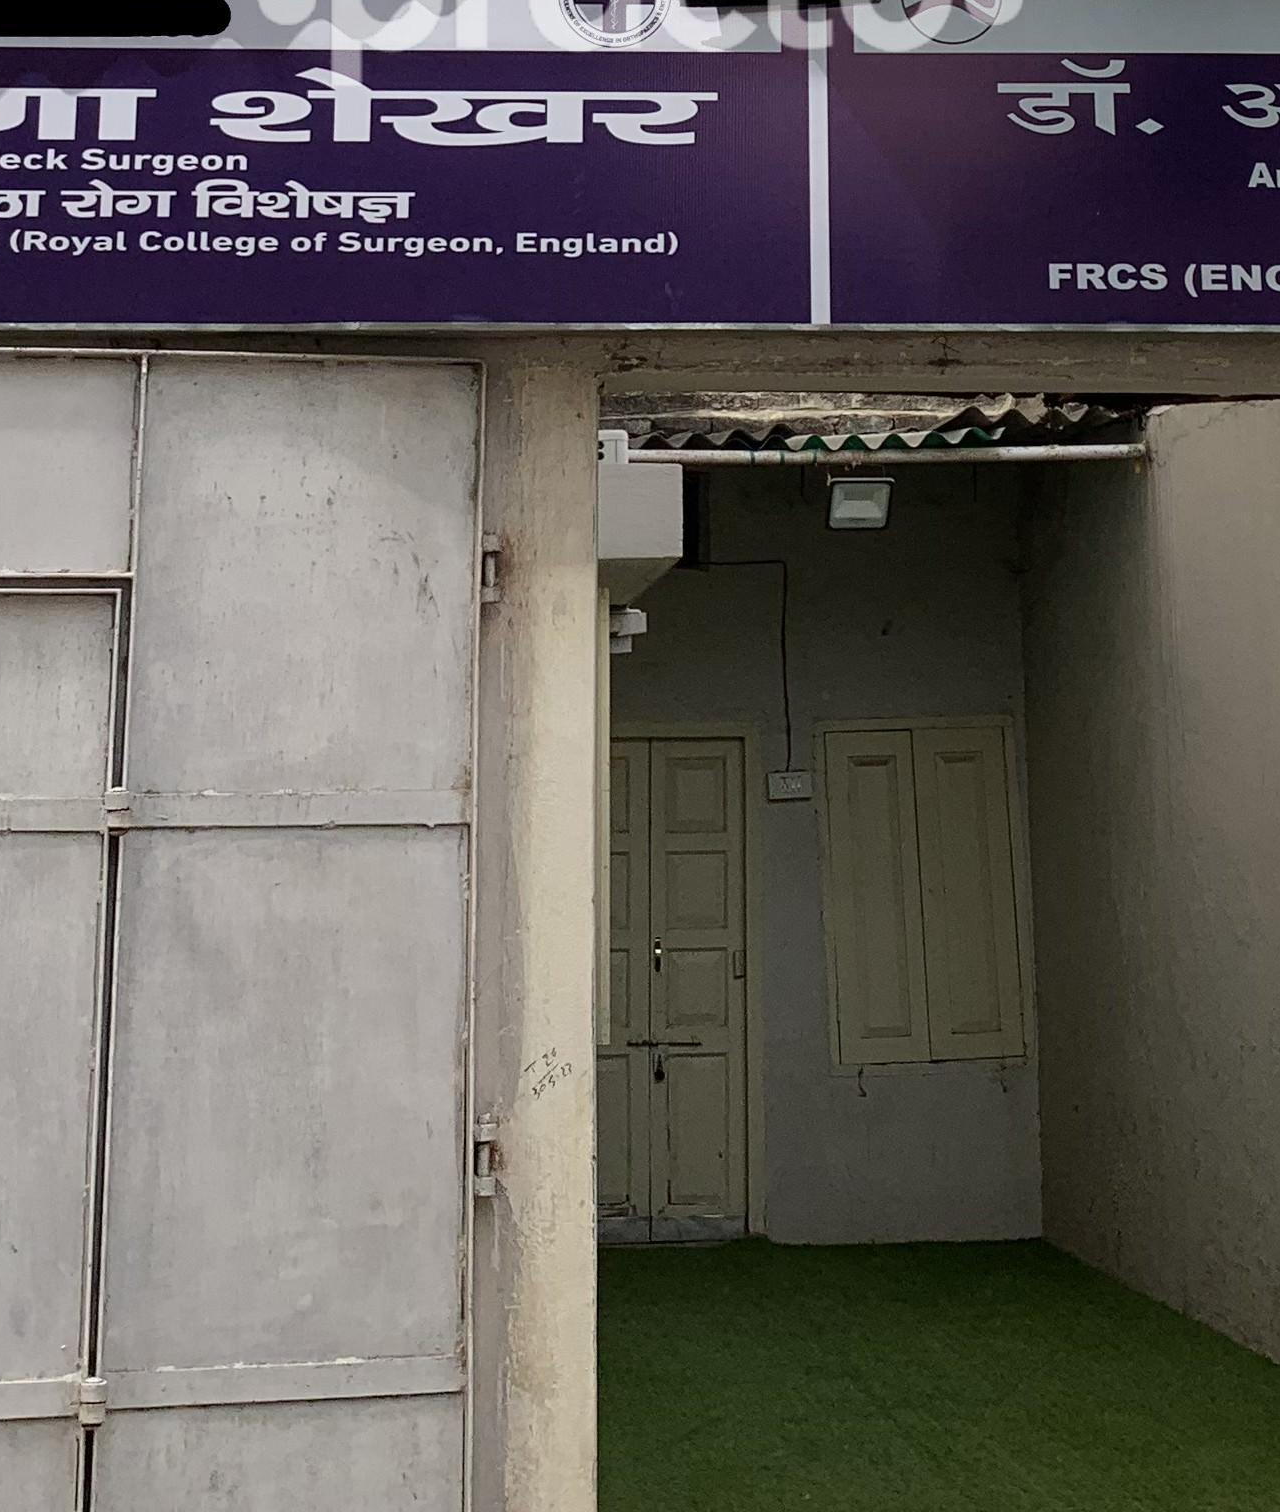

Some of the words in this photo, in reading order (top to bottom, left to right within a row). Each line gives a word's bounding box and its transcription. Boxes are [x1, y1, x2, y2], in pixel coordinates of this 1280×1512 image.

[210, 67, 719, 147] शेखर
[998, 59, 1163, 136] डॉ.
[81, 149, 248, 175] Surgeon
[61, 179, 177, 218] रोग
[191, 178, 416, 224] विशेषज्ञ
[10, 229, 126, 256] (Royal
[139, 231, 278, 257] College
[291, 232, 328, 252] of
[338, 232, 504, 258] Surgeon,
[516, 232, 679, 258] England)
[1048, 263, 1168, 290] FRCS
